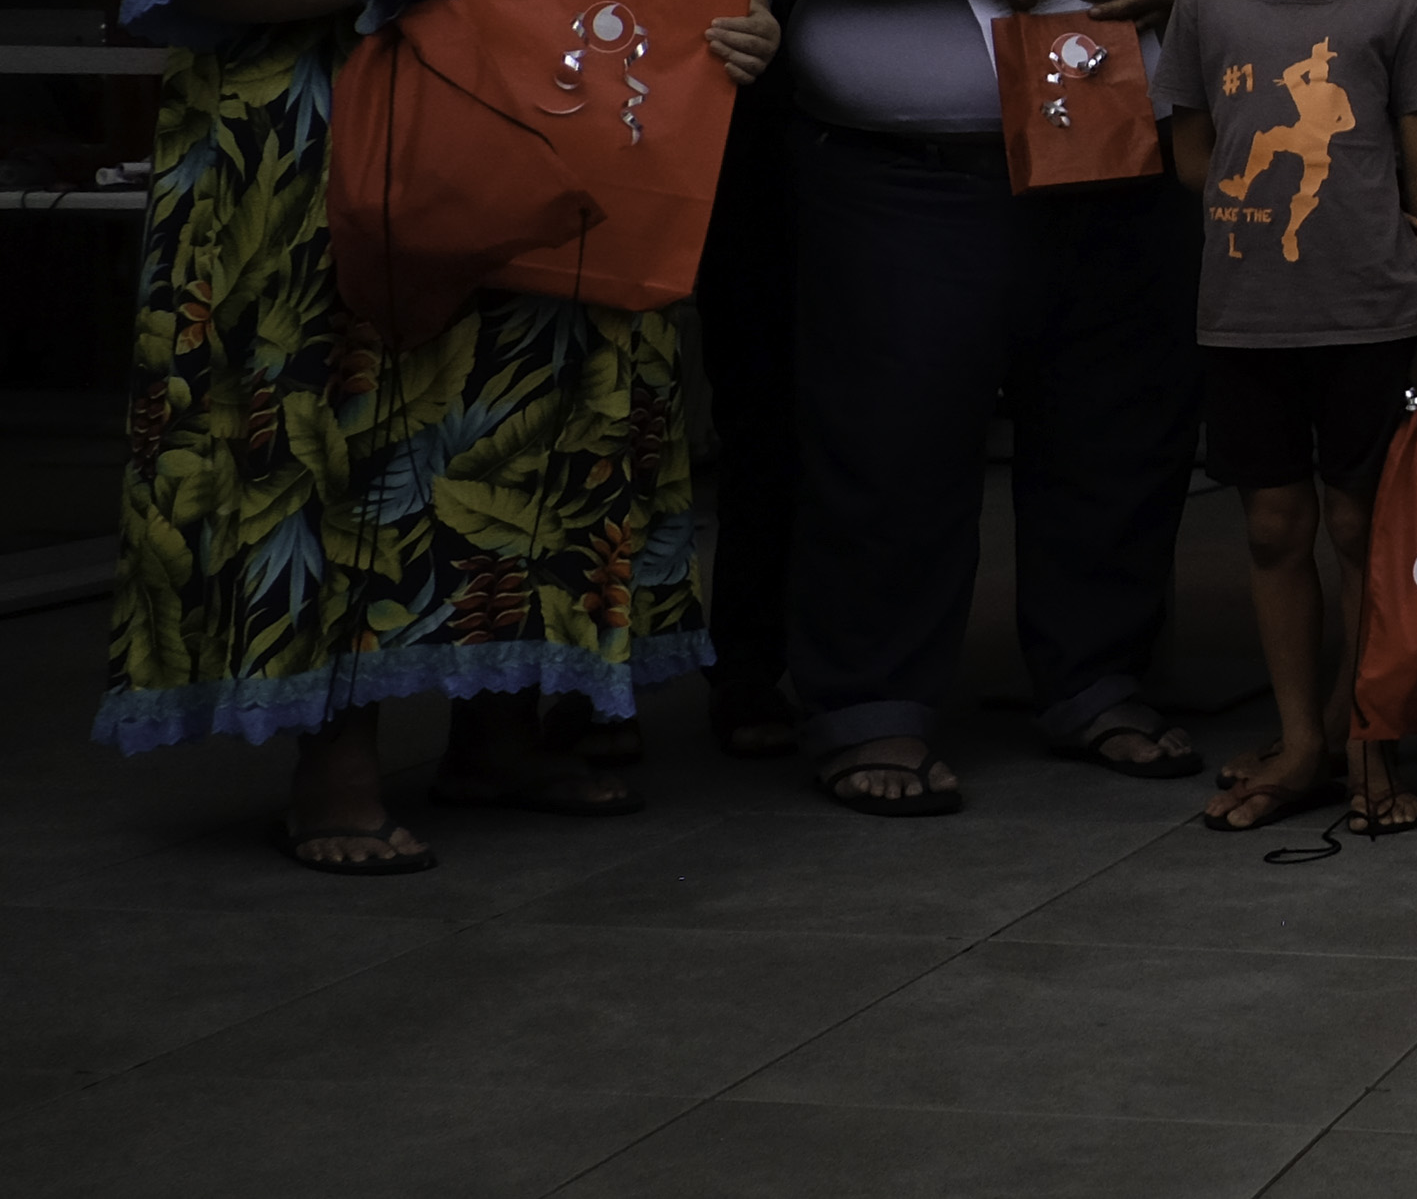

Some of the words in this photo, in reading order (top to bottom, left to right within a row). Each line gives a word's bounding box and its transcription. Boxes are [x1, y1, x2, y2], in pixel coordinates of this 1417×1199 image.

[1221, 63, 1254, 97] #1
[1208, 206, 1240, 223] TAKE
[1242, 206, 1273, 224] THE
[1228, 231, 1243, 259] L
